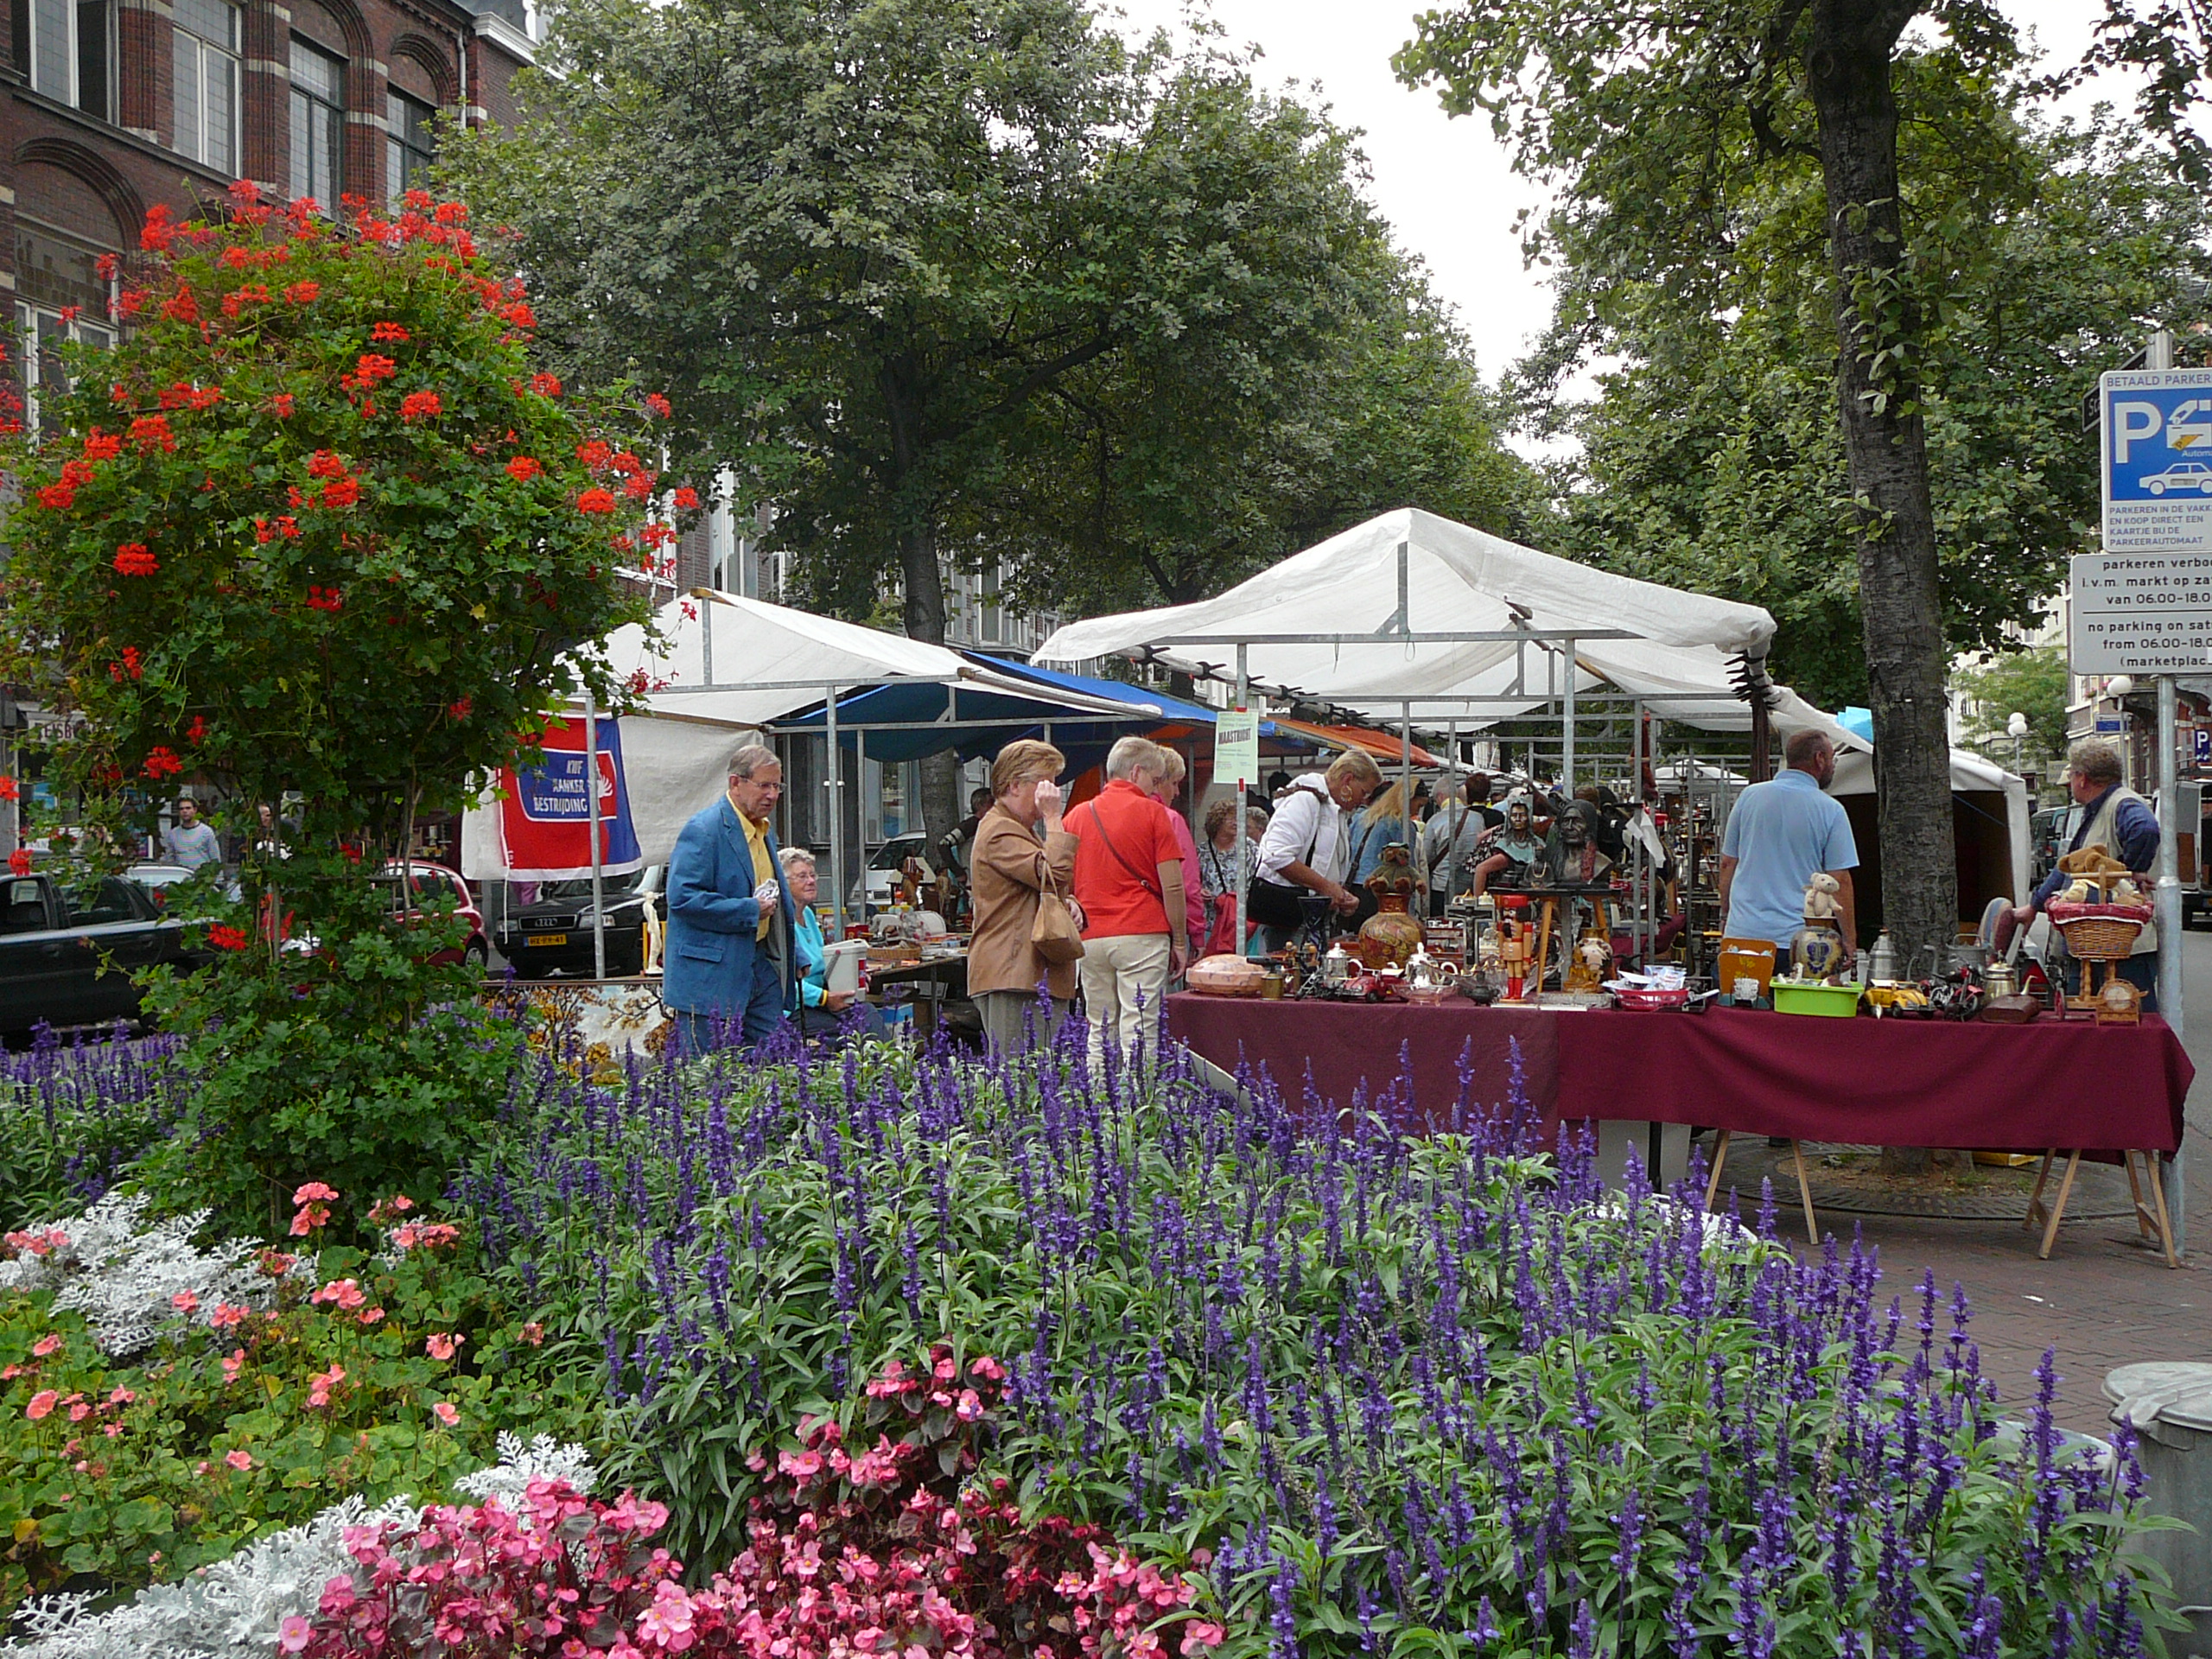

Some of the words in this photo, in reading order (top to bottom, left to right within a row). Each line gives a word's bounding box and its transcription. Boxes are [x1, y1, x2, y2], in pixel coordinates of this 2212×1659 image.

[2107, 376, 2160, 387] BETAALD
[2164, 373, 2212, 385] PARKER
[2113, 401, 2162, 464] P
[2109, 505, 2158, 515] PARKEREN
[2160, 505, 2169, 513] IN
[2171, 505, 2183, 513] DE
[2186, 504, 2212, 512] VAKK
[2109, 517, 2121, 525] EN
[2124, 517, 2149, 525] KOOP
[2152, 515, 2183, 524] DIRECT
[2186, 515, 2203, 524] EEN
[2109, 527, 2151, 536] KAARTJE
[2109, 536, 2204, 546] PARKEERAUTOMAAT
[2103, 559, 2165, 571] parkeren
[2171, 557, 2212, 569] verbo
[2126, 576, 2169, 586] markt
[2173, 577, 2190, 588] op
[2194, 575, 2212, 585] za
[2106, 596, 2131, 605] van
[2136, 592, 2212, 604] 06.00-18.0
[2088, 623, 2104, 632] no
[2109, 620, 2162, 633] parking
[2167, 622, 2183, 631] on
[2189, 620, 2212, 630] sat
[2103, 639, 2135, 650] from
[2120, 656, 2211, 668] (marketplac
[553, 779, 586, 793] KANKER
[533, 797, 588, 815] BESTRIJDING
